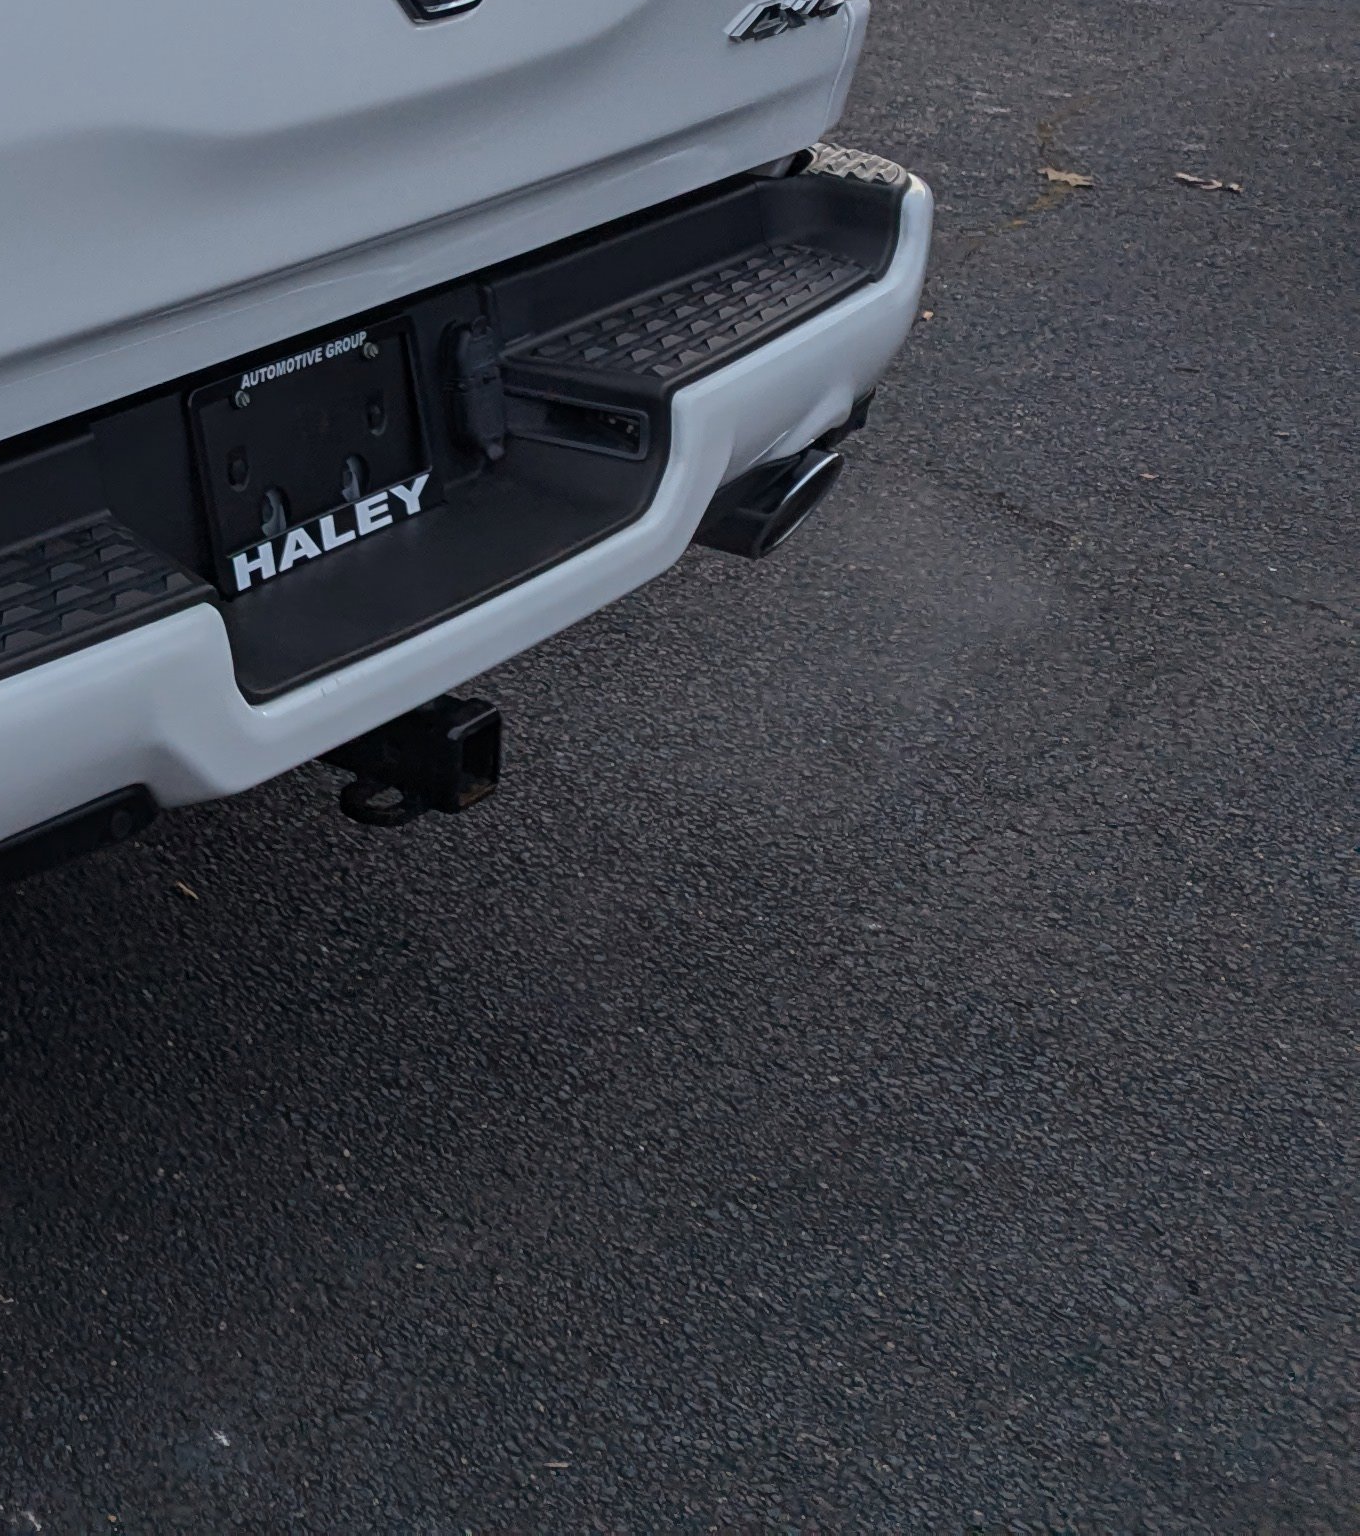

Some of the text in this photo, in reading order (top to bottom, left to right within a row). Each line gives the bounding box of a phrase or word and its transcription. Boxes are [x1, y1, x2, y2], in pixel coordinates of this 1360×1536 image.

[240, 330, 368, 390] AUTOMOTIVE GROUP
[232, 472, 430, 592] HALEY
